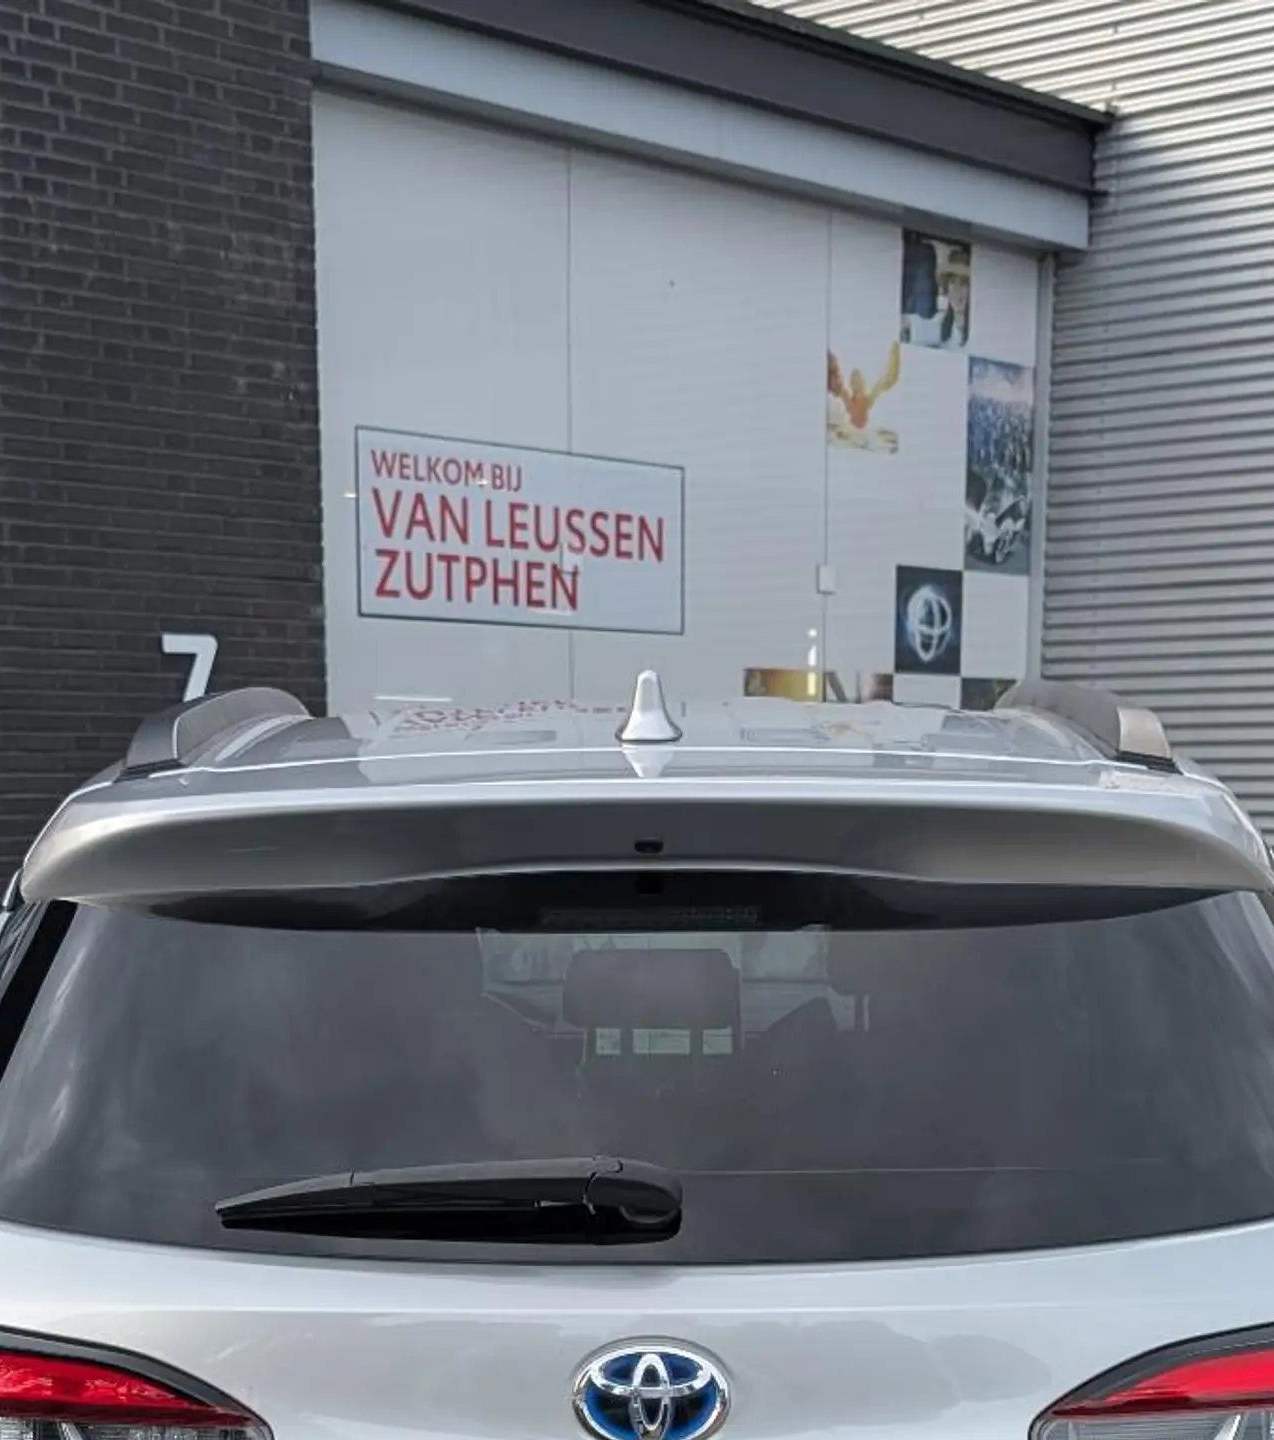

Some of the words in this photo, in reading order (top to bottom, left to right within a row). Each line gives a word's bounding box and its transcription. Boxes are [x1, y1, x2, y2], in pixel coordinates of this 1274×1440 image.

[370, 449, 485, 487] WELKOM
[491, 464, 523, 493] BIJ
[371, 487, 469, 545] VAN
[485, 498, 665, 563] LEUSSEN
[375, 547, 580, 612] ZUTPHEN
[161, 633, 218, 703] 7
